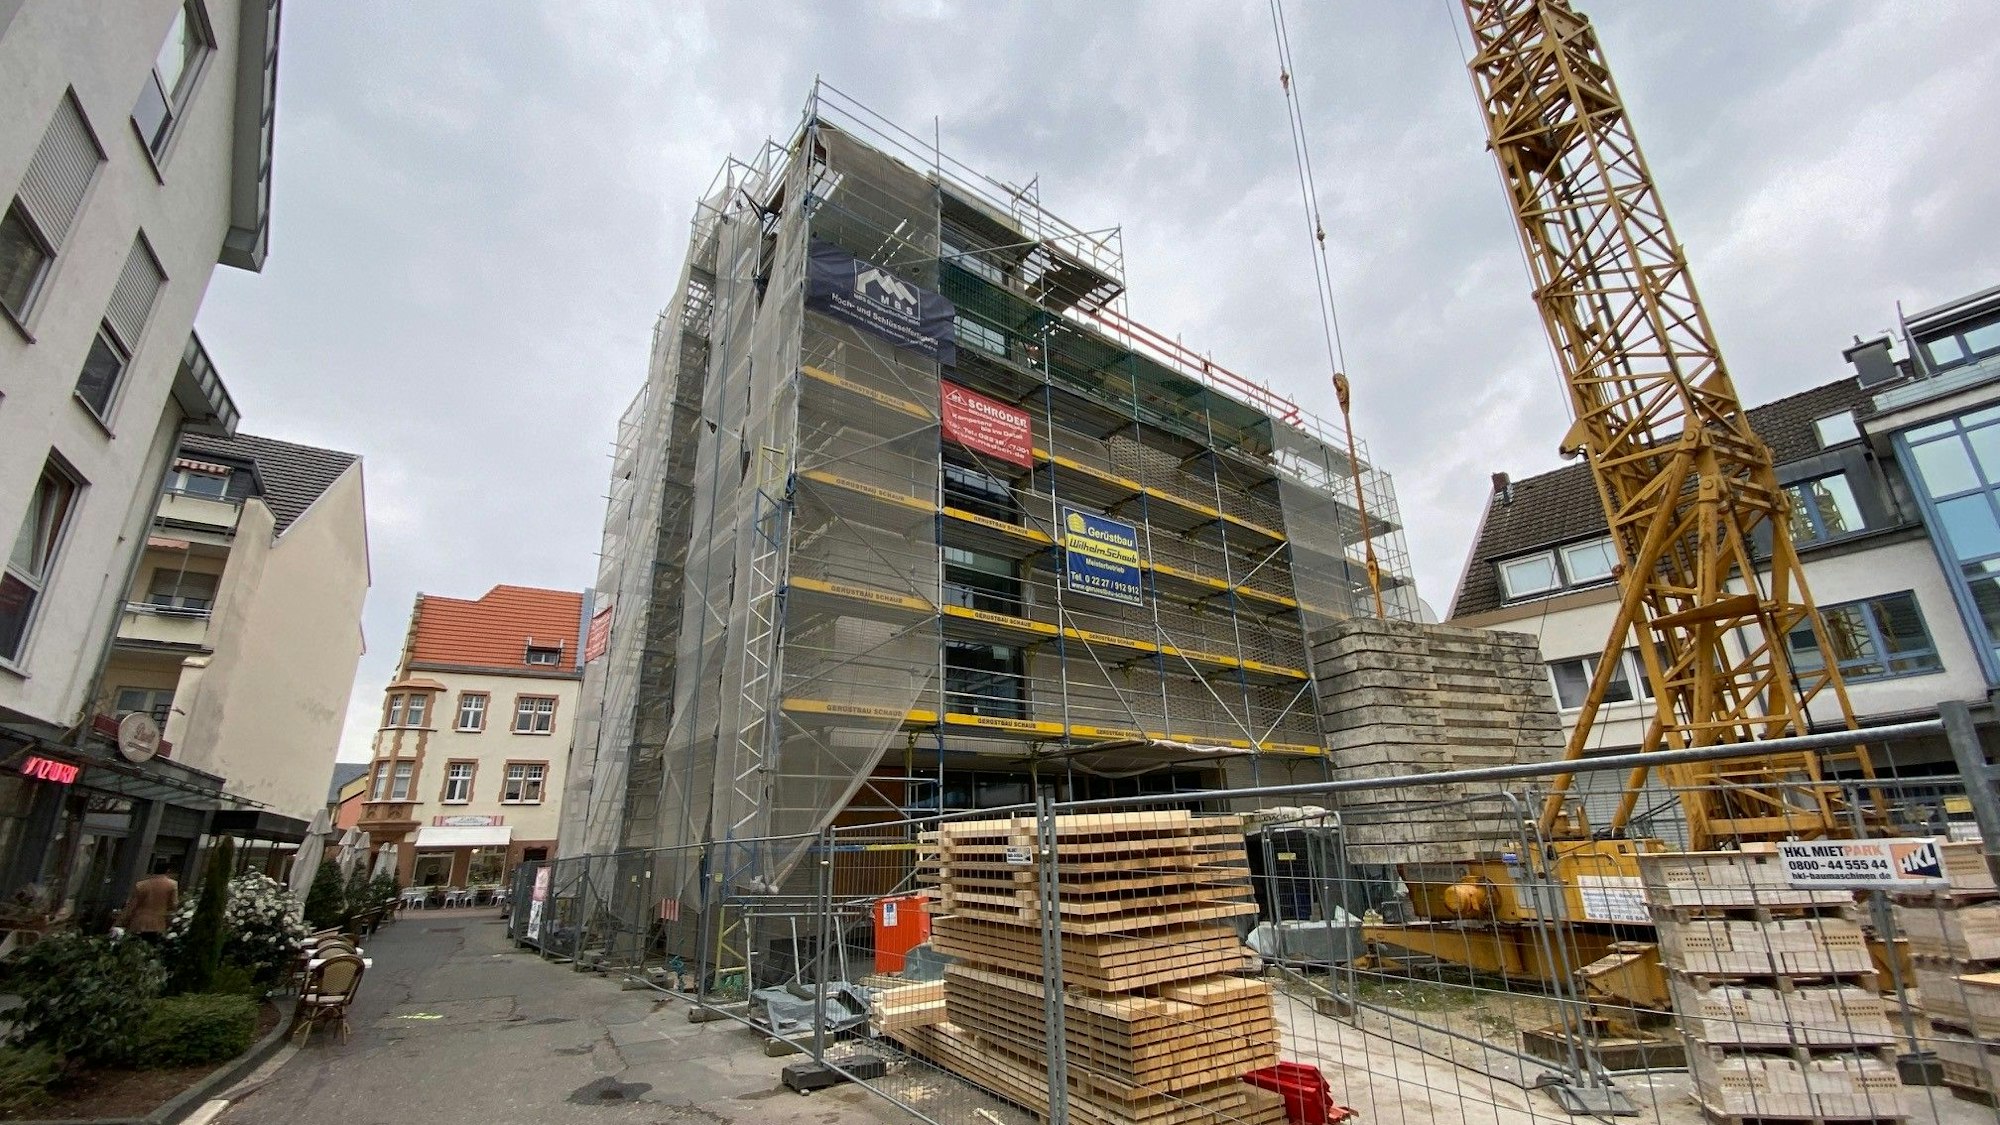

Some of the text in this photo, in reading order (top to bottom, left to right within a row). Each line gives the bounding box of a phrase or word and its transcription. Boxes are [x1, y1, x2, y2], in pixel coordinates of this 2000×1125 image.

[831, 292, 855, 310] Hoch-
[856, 305, 871, 318] und
[968, 398, 1028, 428] SCHRÖDER
[1088, 527, 1132, 546] Gerüstbau
[1085, 558, 1125, 573] Meisterbetrieb
[1085, 575, 1090, 583] 0
[1091, 575, 1101, 585] 22
[1101, 578, 1110, 587] 27
[1115, 581, 1127, 592] 912
[1128, 585, 1139, 595] 912
[1784, 846, 1811, 858] HKL
[1898, 843, 1937, 873] HKL
[1789, 859, 1819, 871] 0800
[1827, 859, 1843, 871] 44
[1844, 859, 1869, 871] 555
[1871, 859, 1888, 870] 44
[1791, 871, 1892, 880] hkl-baumaschinende
